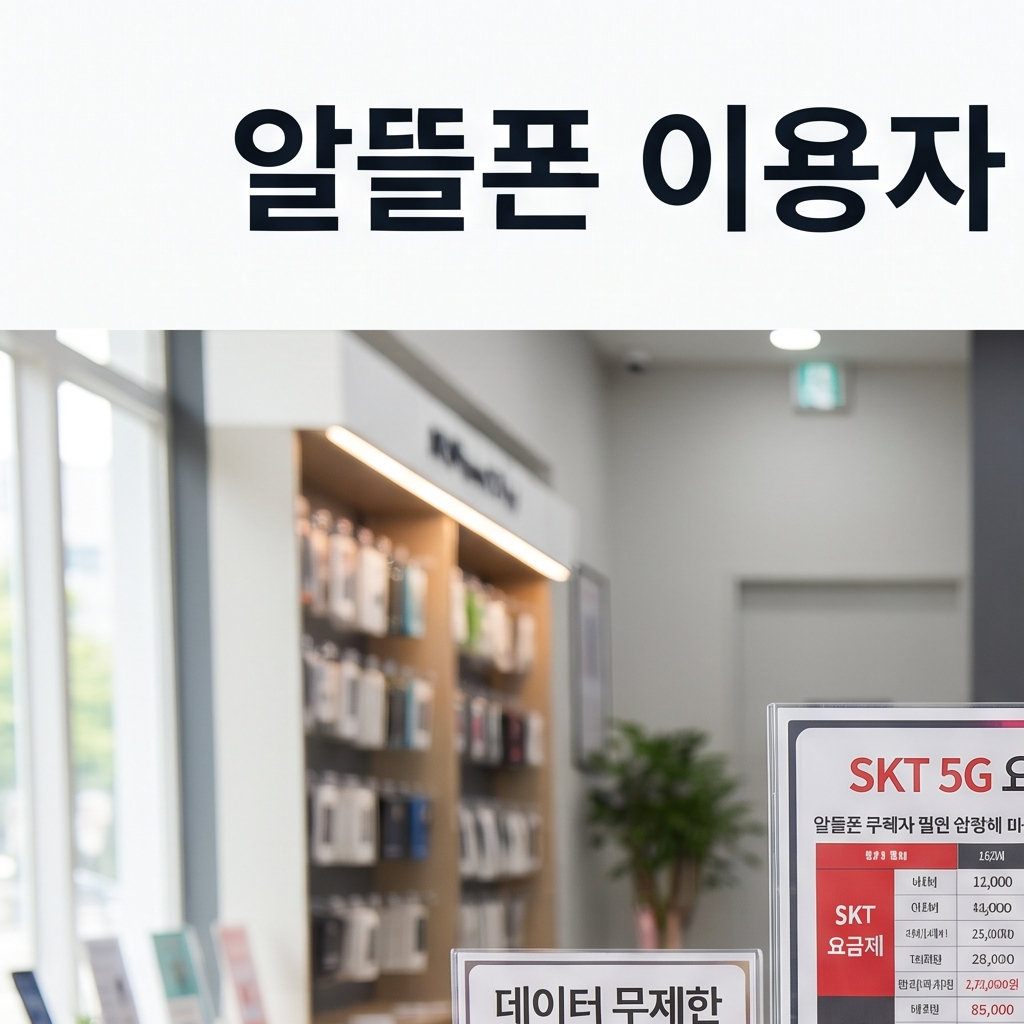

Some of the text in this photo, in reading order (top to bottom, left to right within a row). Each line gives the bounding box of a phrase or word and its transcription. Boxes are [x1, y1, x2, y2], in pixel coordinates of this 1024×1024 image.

[849, 756, 930, 793] SKT
[938, 757, 992, 793] 5G
[835, 904, 877, 926] SKT
[827, 934, 884, 957] 요금제
[971, 1003, 1015, 1018] 85,000
